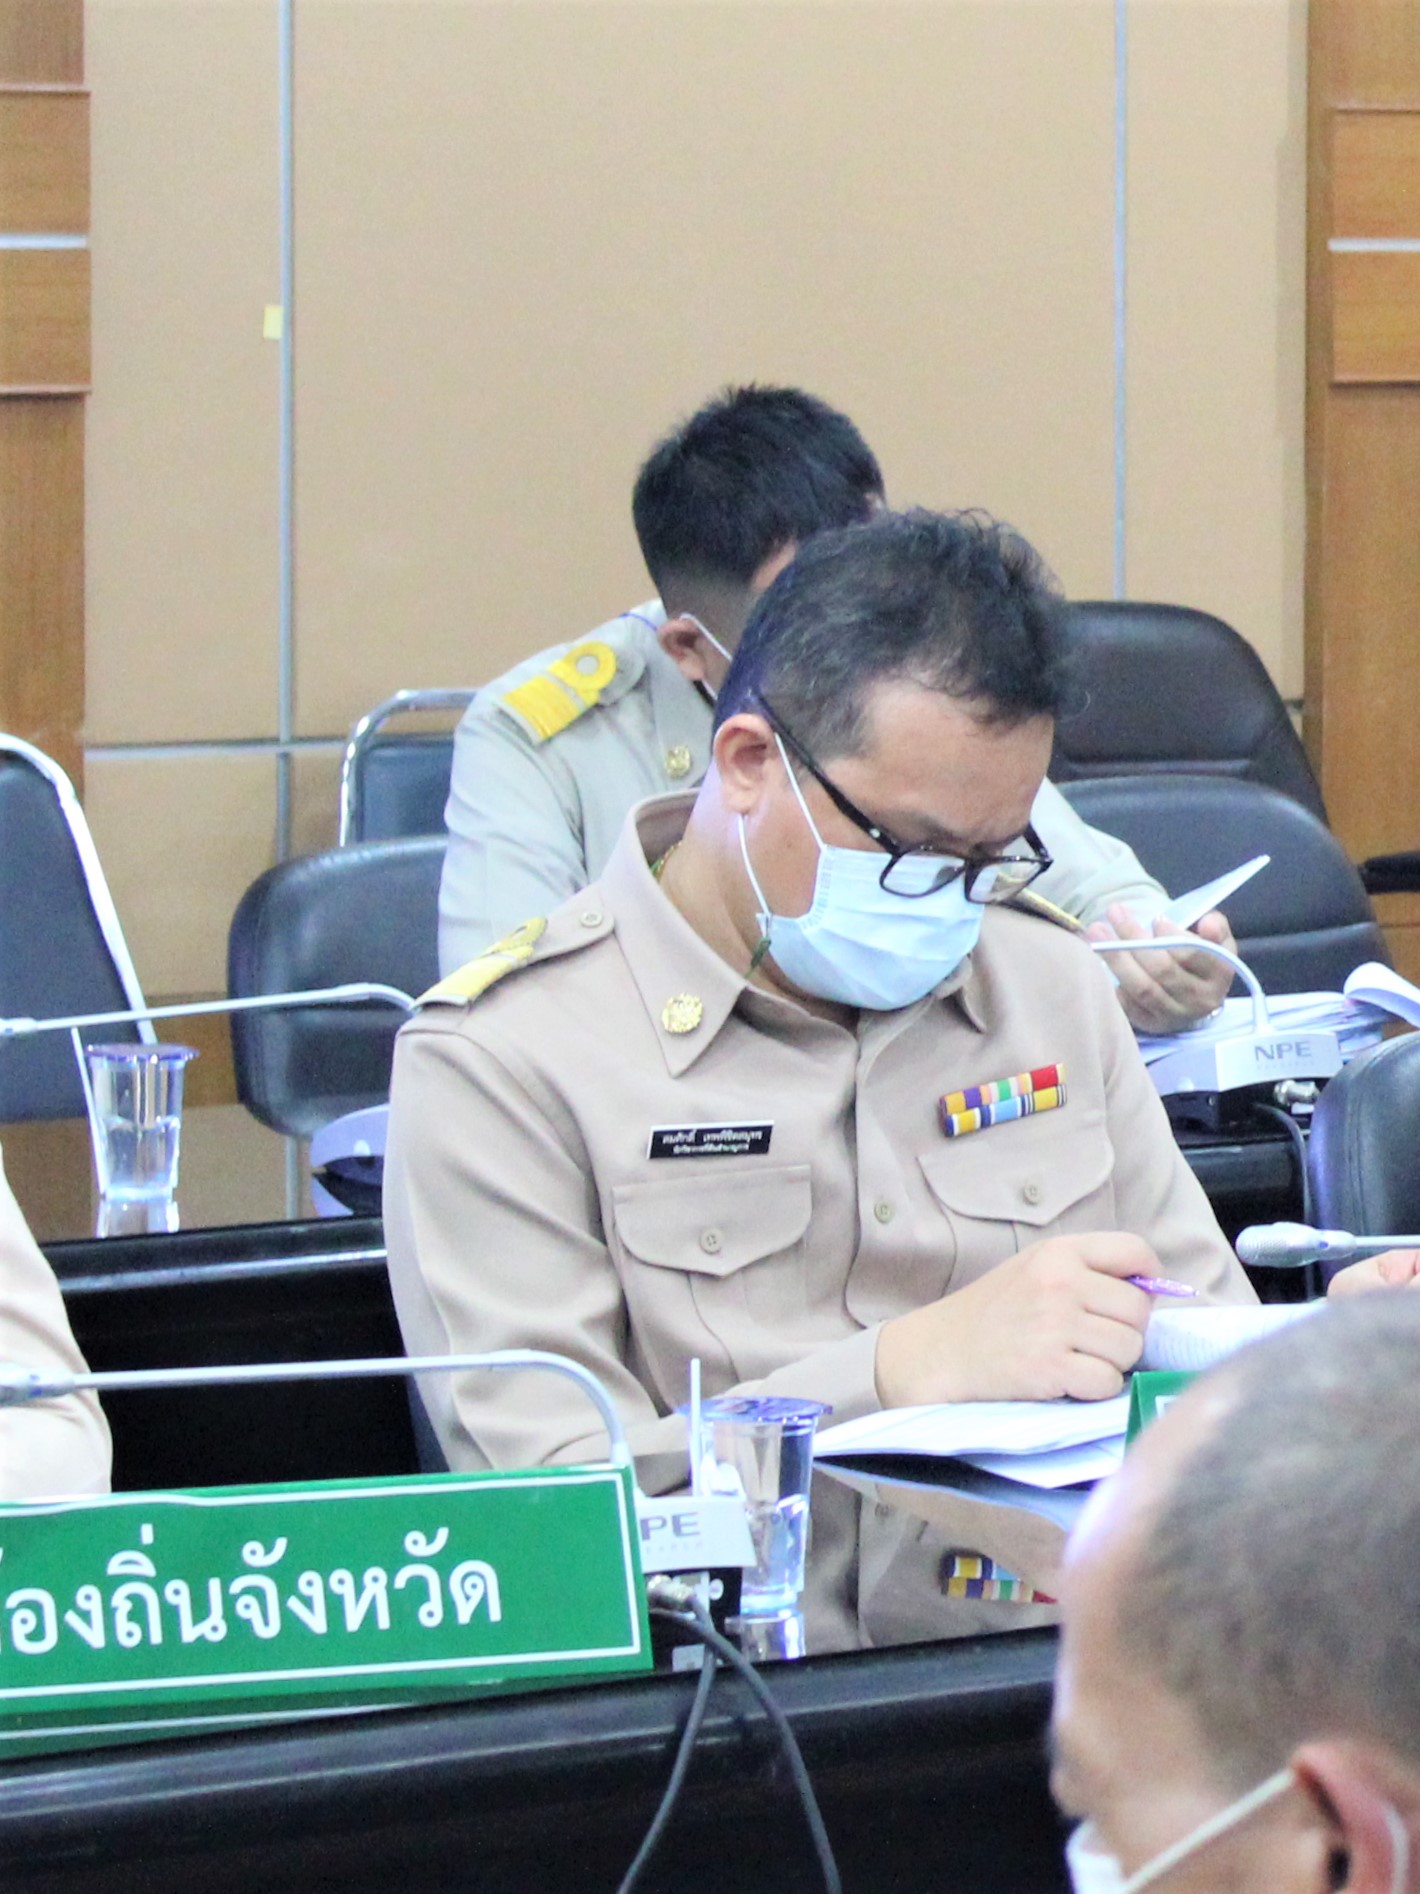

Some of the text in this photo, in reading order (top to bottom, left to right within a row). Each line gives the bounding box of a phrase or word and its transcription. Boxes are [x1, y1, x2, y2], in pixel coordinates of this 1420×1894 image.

[1254, 1040, 1312, 1062] NPE
[640, 1511, 701, 1540] PE
[0, 1523, 503, 1655] องถิ่นจังหวัด
